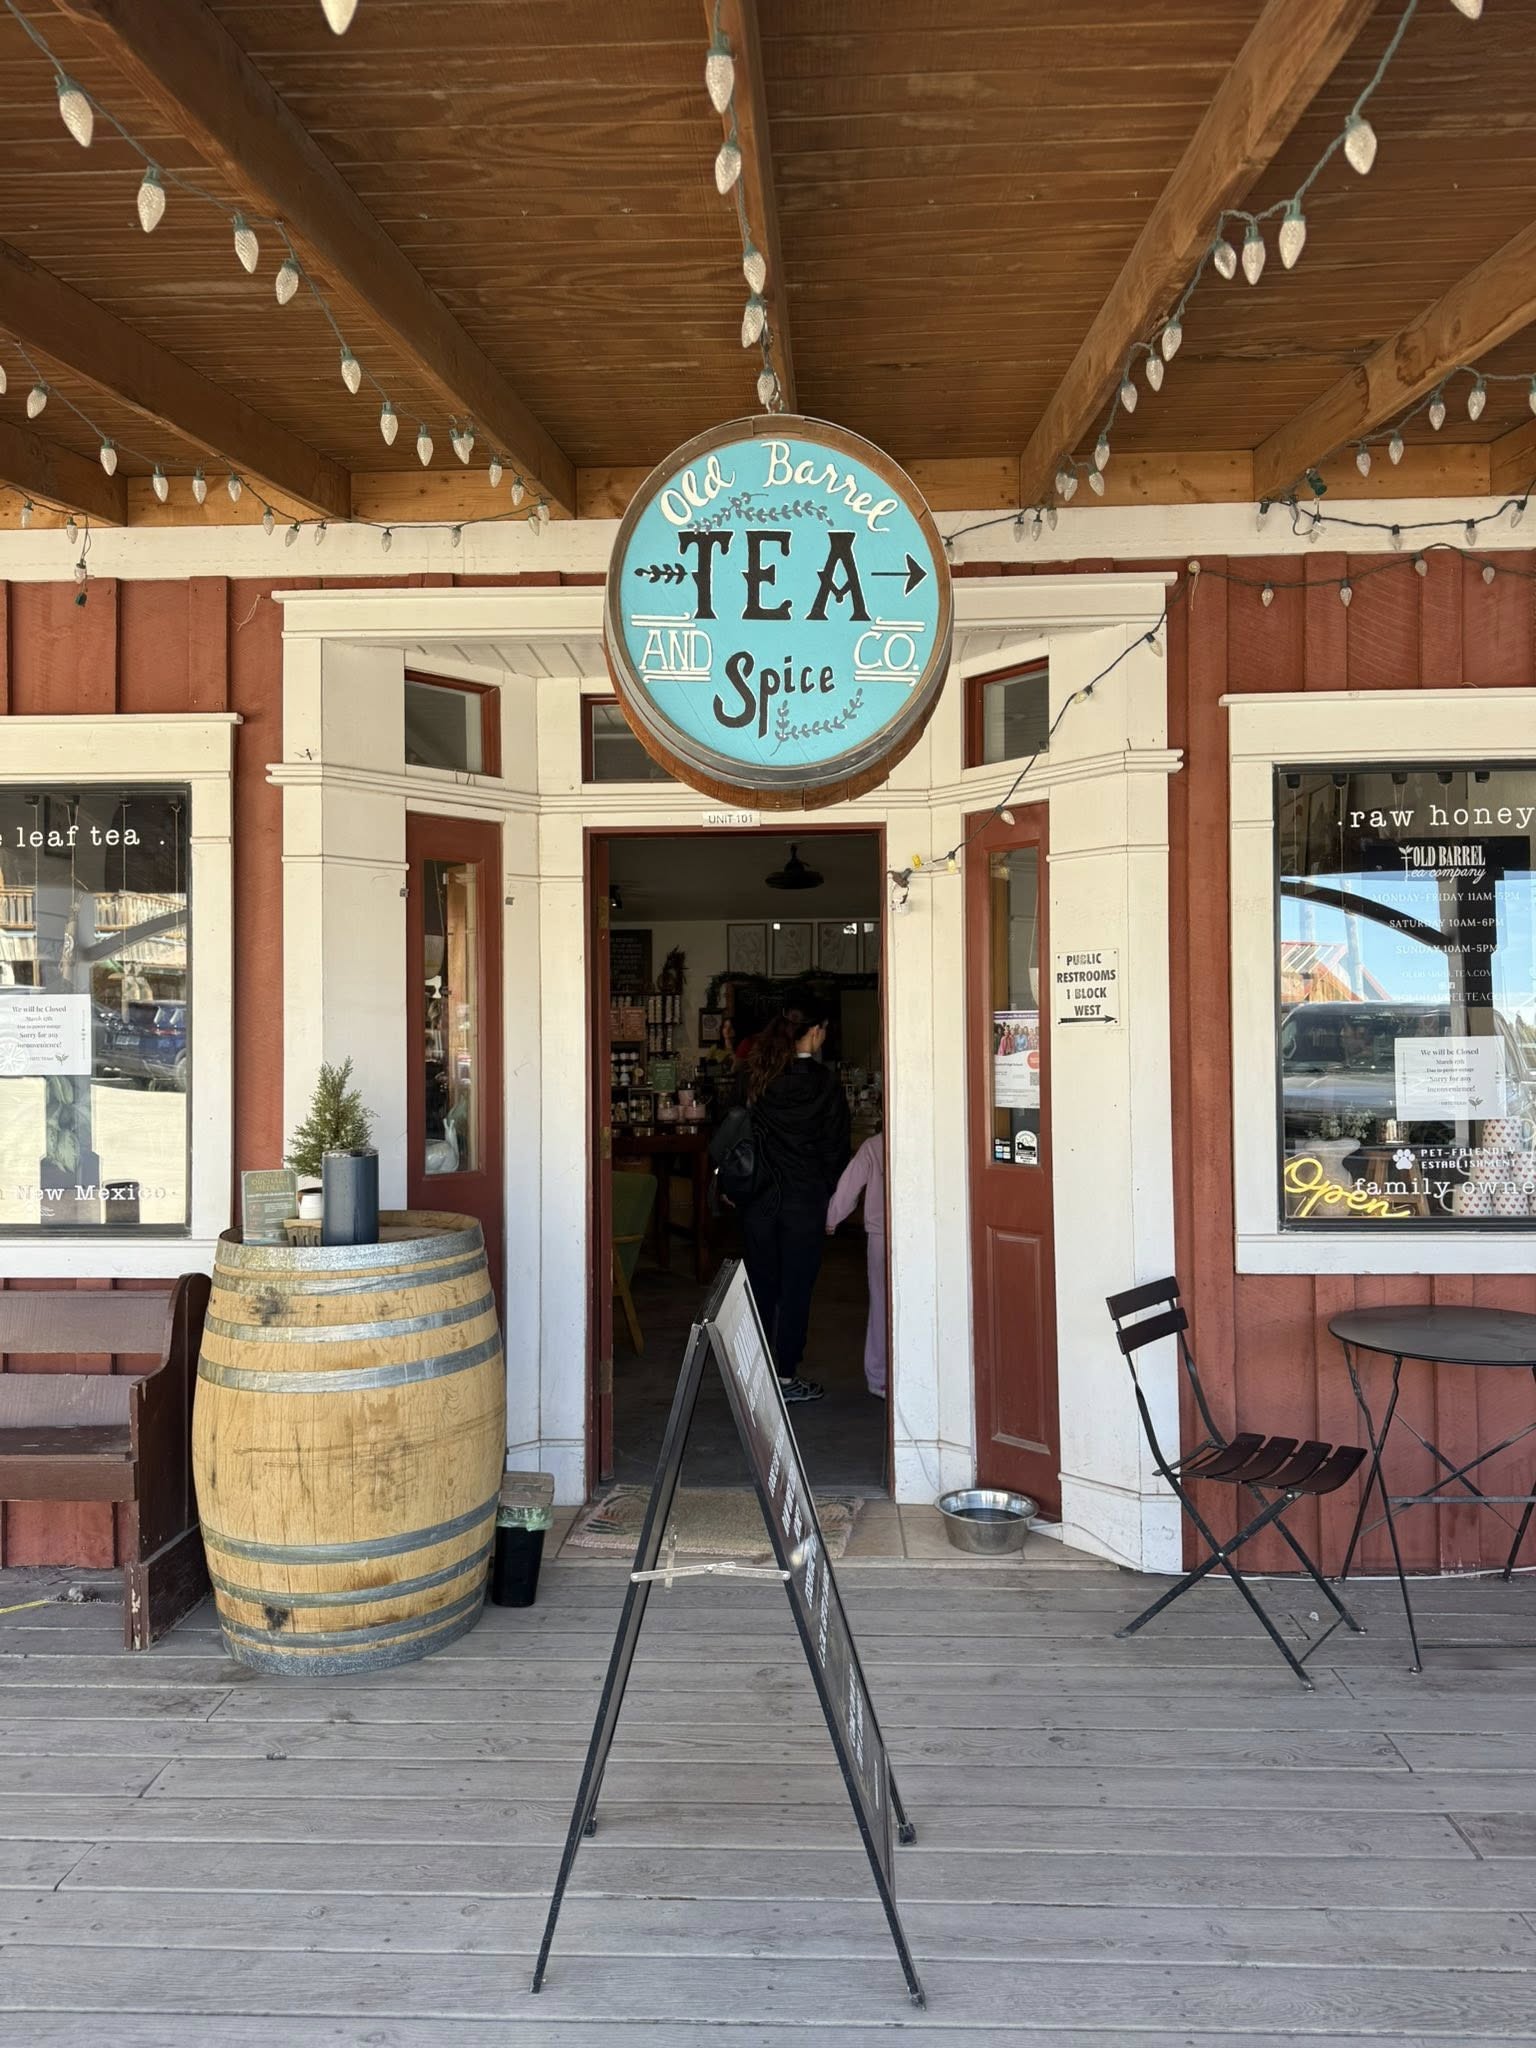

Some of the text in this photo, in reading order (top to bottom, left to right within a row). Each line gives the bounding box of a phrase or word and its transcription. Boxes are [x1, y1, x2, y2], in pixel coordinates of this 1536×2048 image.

[660, 440, 898, 532] Old Barrel
[677, 530, 872, 622] TEA
[639, 629, 713, 672] AND
[855, 630, 919, 672] CO.
[713, 650, 835, 739] Spice
[708, 814, 753, 824] UNIT 101
[1430, 805, 1535, 829] honey
[16, 825, 79, 848] leaf
[90, 825, 140, 846] tea
[1413, 845, 1486, 867] OLD BARREL
[1389, 918, 1504, 928] SATURDAY 10AM-6PM
[1396, 944, 1499, 954] SUNDAY 10AM-5PM
[1066, 953, 1102, 966] PUBLIC
[1057, 969, 1116, 983] RESTROOMS
[1066, 987, 1107, 1000] 1 BLOCK
[1074, 1005, 1101, 1016] WEST
[1421, 1147, 1516, 1157] PET-FRIENDLY
[1421, 1159, 1517, 1170] ESTABLISHMENT
[17, 1185, 65, 1200] New
[75, 1185, 166, 1201] Mexico
[1284, 1157, 1411, 1217] Open
[1354, 1178, 1451, 1198] family
